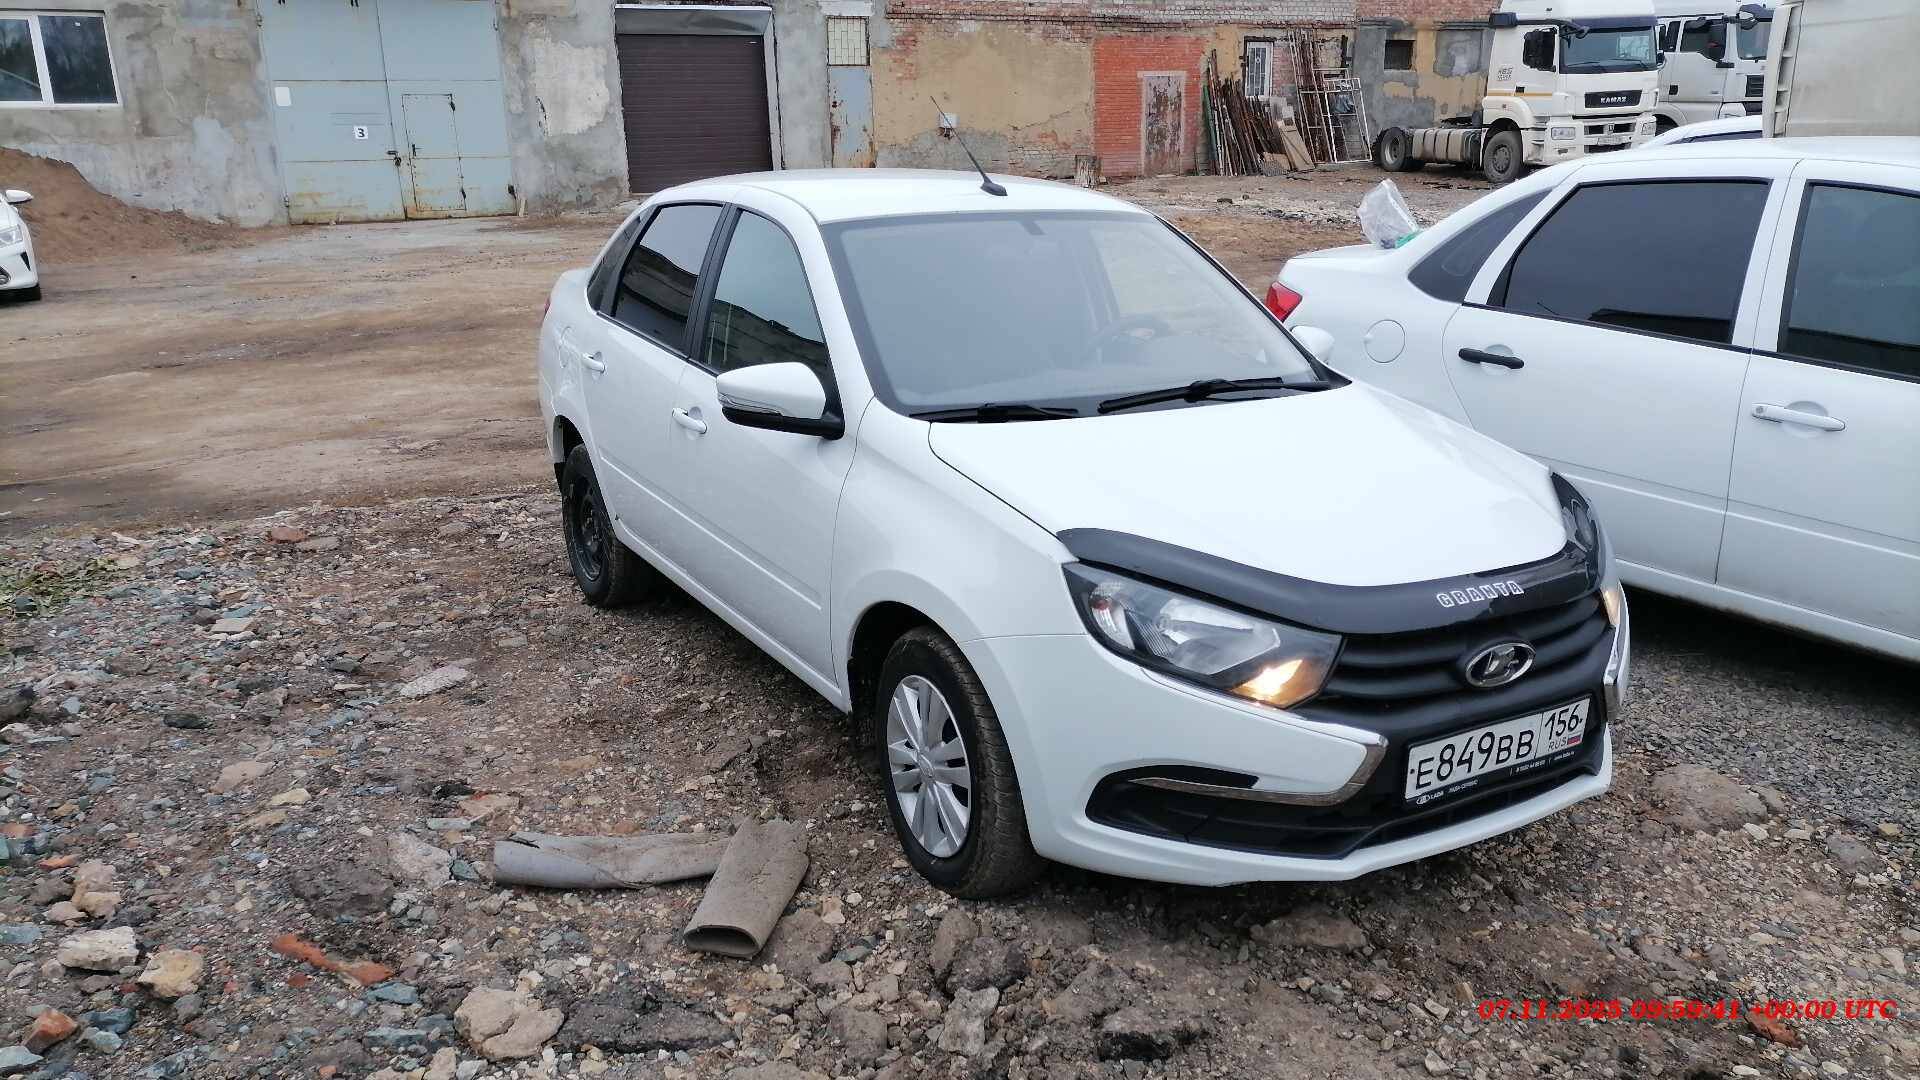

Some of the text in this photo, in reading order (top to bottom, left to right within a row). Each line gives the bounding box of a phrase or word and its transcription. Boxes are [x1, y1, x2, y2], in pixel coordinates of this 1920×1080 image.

[1600, 96, 1627, 104] KAMAZ
[357, 127, 365, 138] 3
[1436, 581, 1525, 608] GRANTA
[1544, 704, 1581, 741] 156
[1547, 738, 1567, 751] RUS
